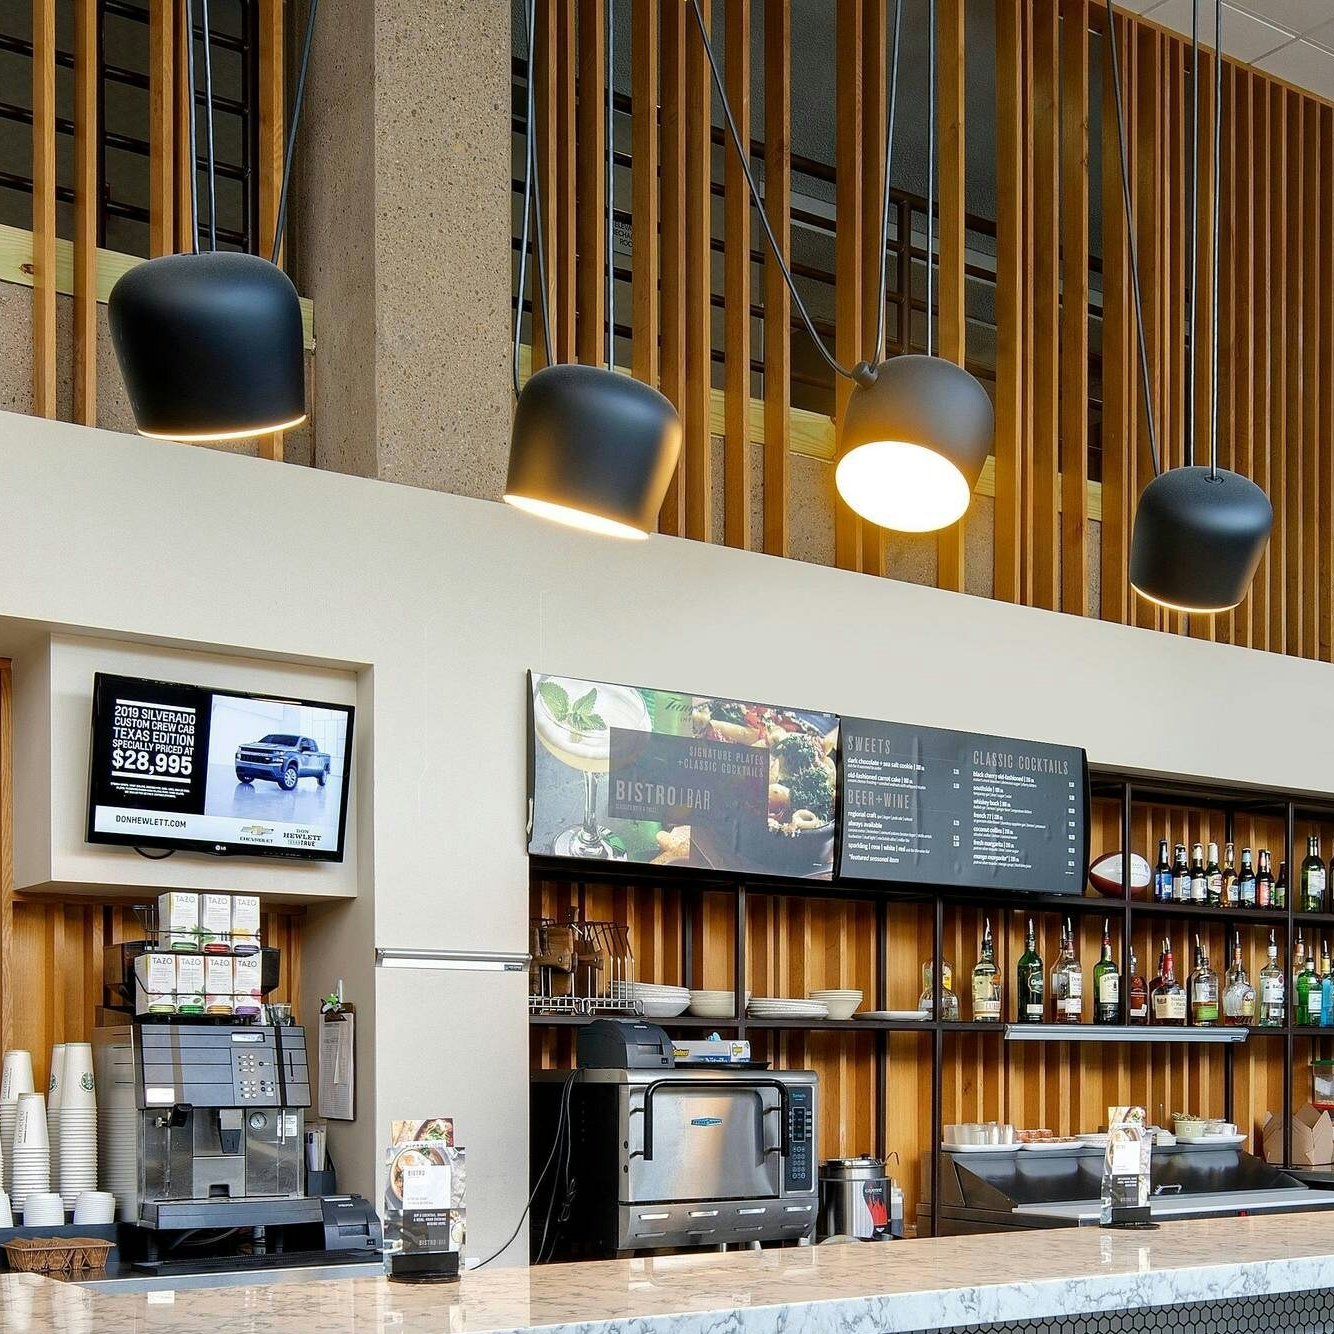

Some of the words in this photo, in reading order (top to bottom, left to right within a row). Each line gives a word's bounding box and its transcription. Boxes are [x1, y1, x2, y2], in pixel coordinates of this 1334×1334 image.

[114, 706, 139, 718] 2019
[141, 709, 196, 725] SILVERADO
[114, 716, 150, 730] CUSTOM
[151, 721, 177, 732] CREW
[177, 725, 195, 734] CAB
[112, 727, 150, 741] TEXAS
[152, 731, 195, 747] EDITION
[847, 735, 891, 754] SWEETS
[112, 739, 154, 752] SPECIALLY
[155, 744, 182, 754] PRICED
[184, 747, 195, 756] AT
[112, 747, 193, 775] $28,995
[689, 746, 732, 762] SIGNATURE
[735, 752, 764, 765] PLATES
[973, 750, 1013, 768] CLASSIC
[1018, 755, 1069, 775] COCKTAILS
[721, 763, 764, 778] COCKTAILS
[616, 780, 676, 806] BISTRO
[686, 788, 711, 810] BAR
[115, 815, 187, 828] DONHEWLETT.COM
[283, 832, 322, 841] HEWLETT
[175, 895, 196, 903] TAZO
[208, 897, 228, 905] TAZO
[237, 899, 257, 907] TAZO
[152, 957, 173, 965] TAZO
[181, 958, 202, 966] TAZO
[210, 959, 230, 967] TAZO
[238, 960, 258, 968] TAZO
